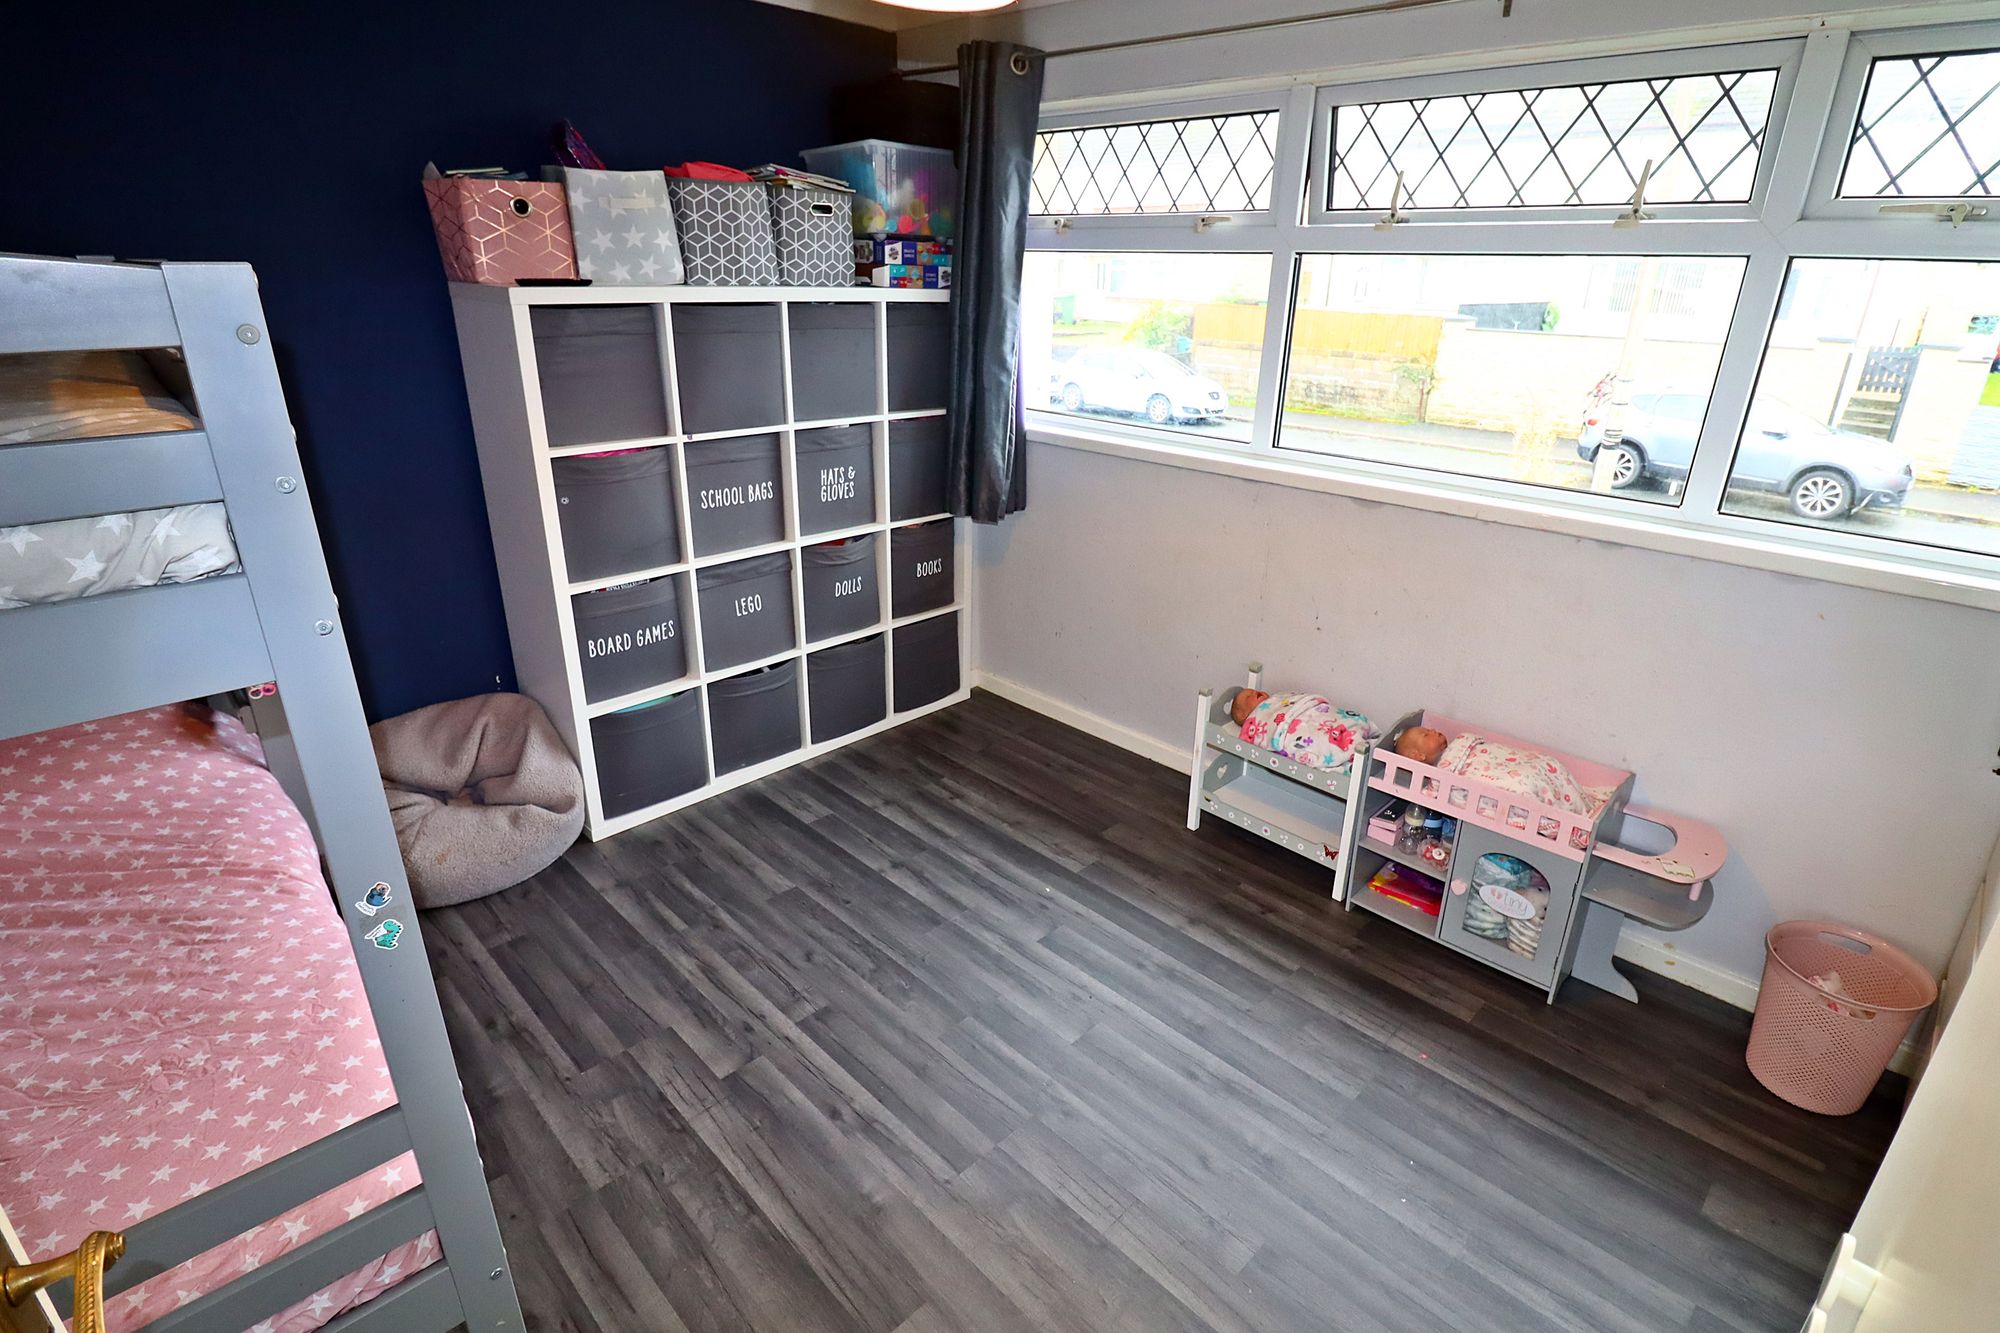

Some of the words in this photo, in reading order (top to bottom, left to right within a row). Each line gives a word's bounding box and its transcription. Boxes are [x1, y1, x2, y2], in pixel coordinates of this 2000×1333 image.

[820, 467, 845, 487] HATS
[847, 464, 857, 481] &
[700, 485, 745, 510] SCHOOL
[748, 480, 774, 504] BAGS
[820, 481, 855, 503] GLOVES
[916, 558, 942, 578] BOOKS
[834, 575, 862, 598] DOLLS
[734, 594, 763, 617] LEGO
[587, 632, 632, 658] BOARD
[636, 619, 675, 648] GAMES
